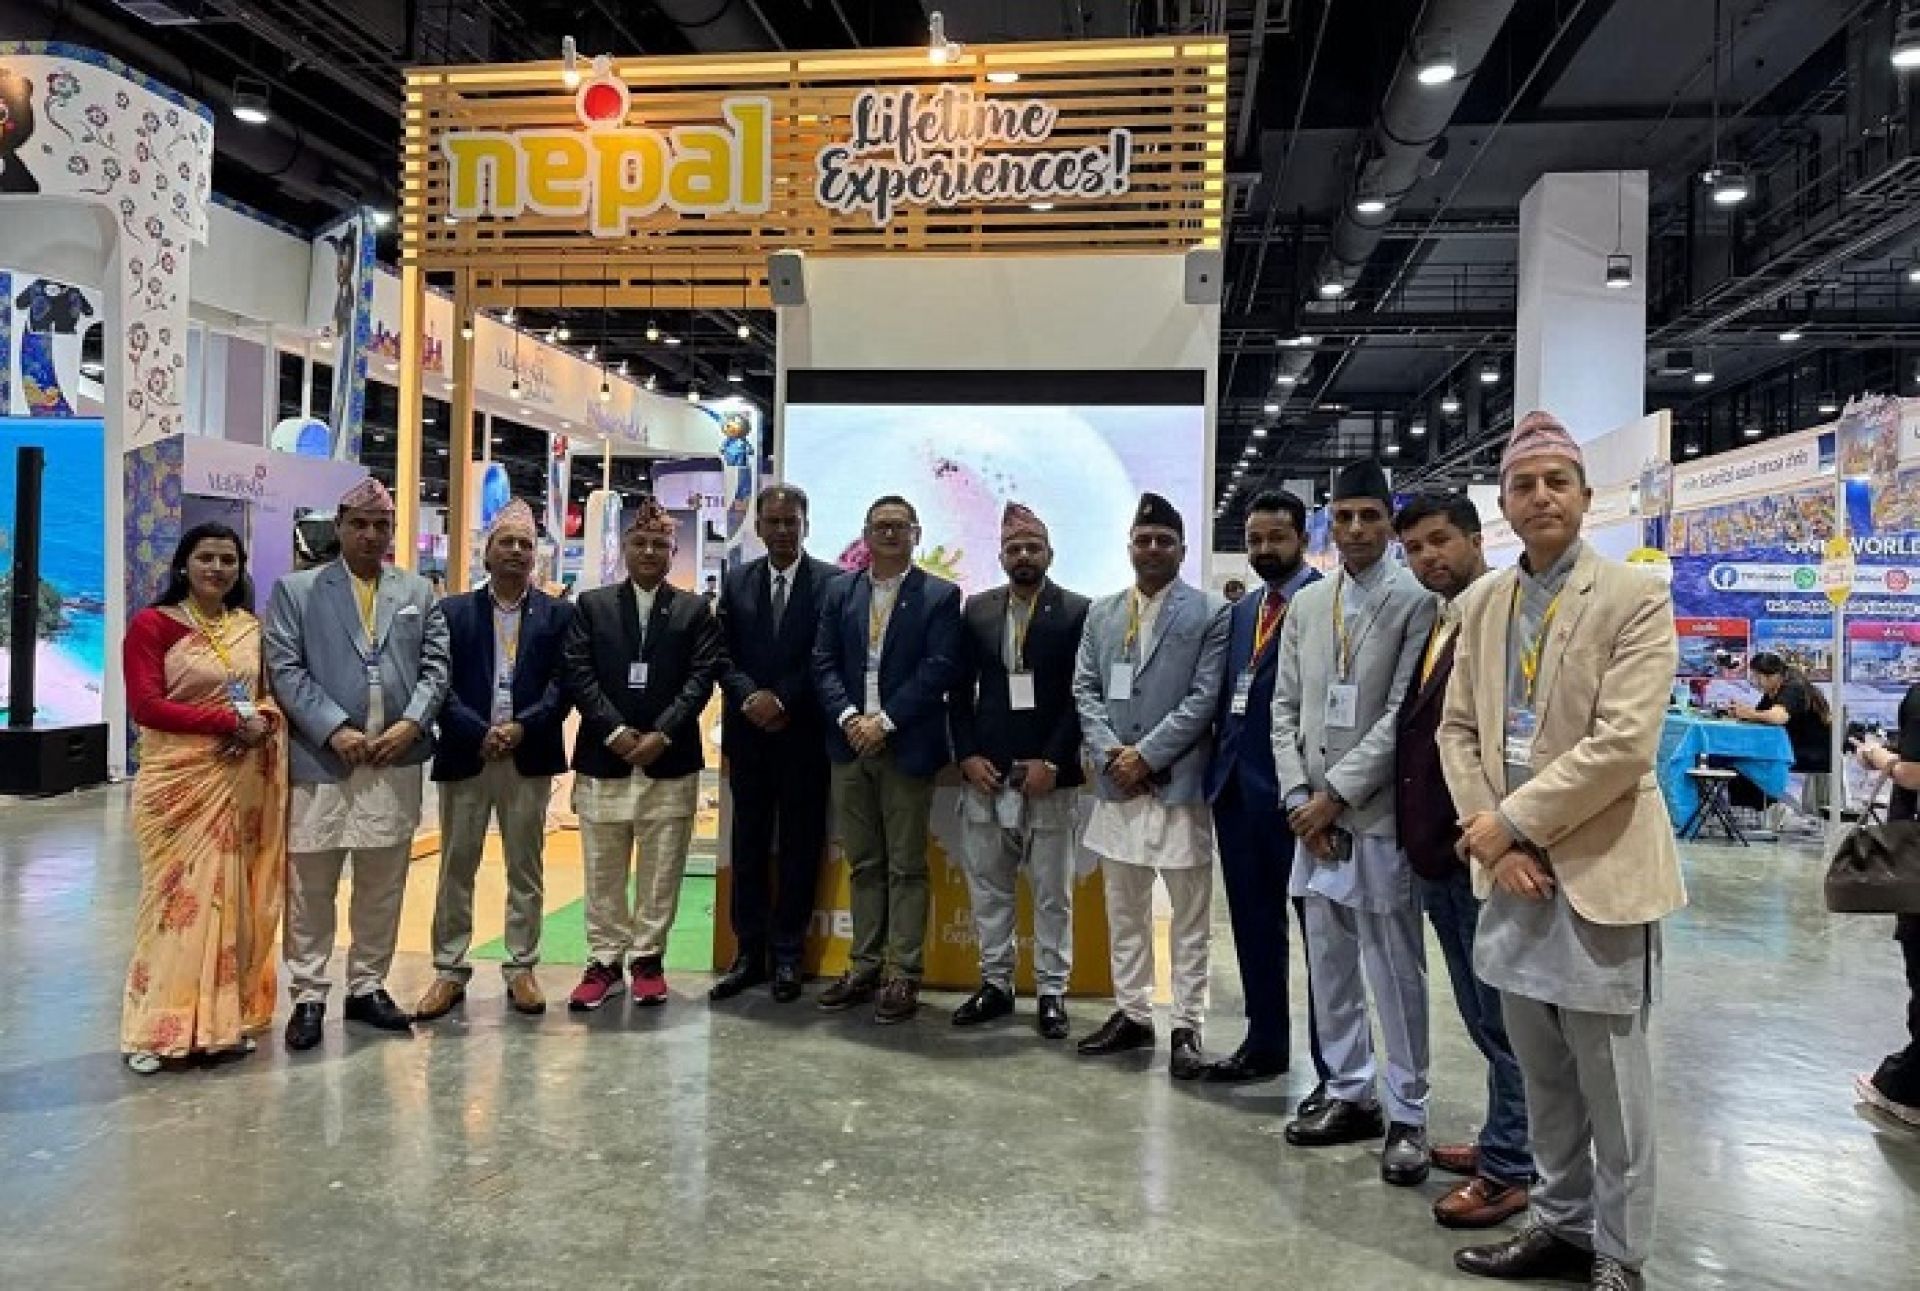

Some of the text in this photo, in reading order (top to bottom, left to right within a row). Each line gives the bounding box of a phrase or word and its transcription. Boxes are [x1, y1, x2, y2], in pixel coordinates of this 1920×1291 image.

[444, 100, 770, 234] nepal
[854, 88, 1054, 165] Lifetime
[820, 133, 1128, 221] Experiences!
